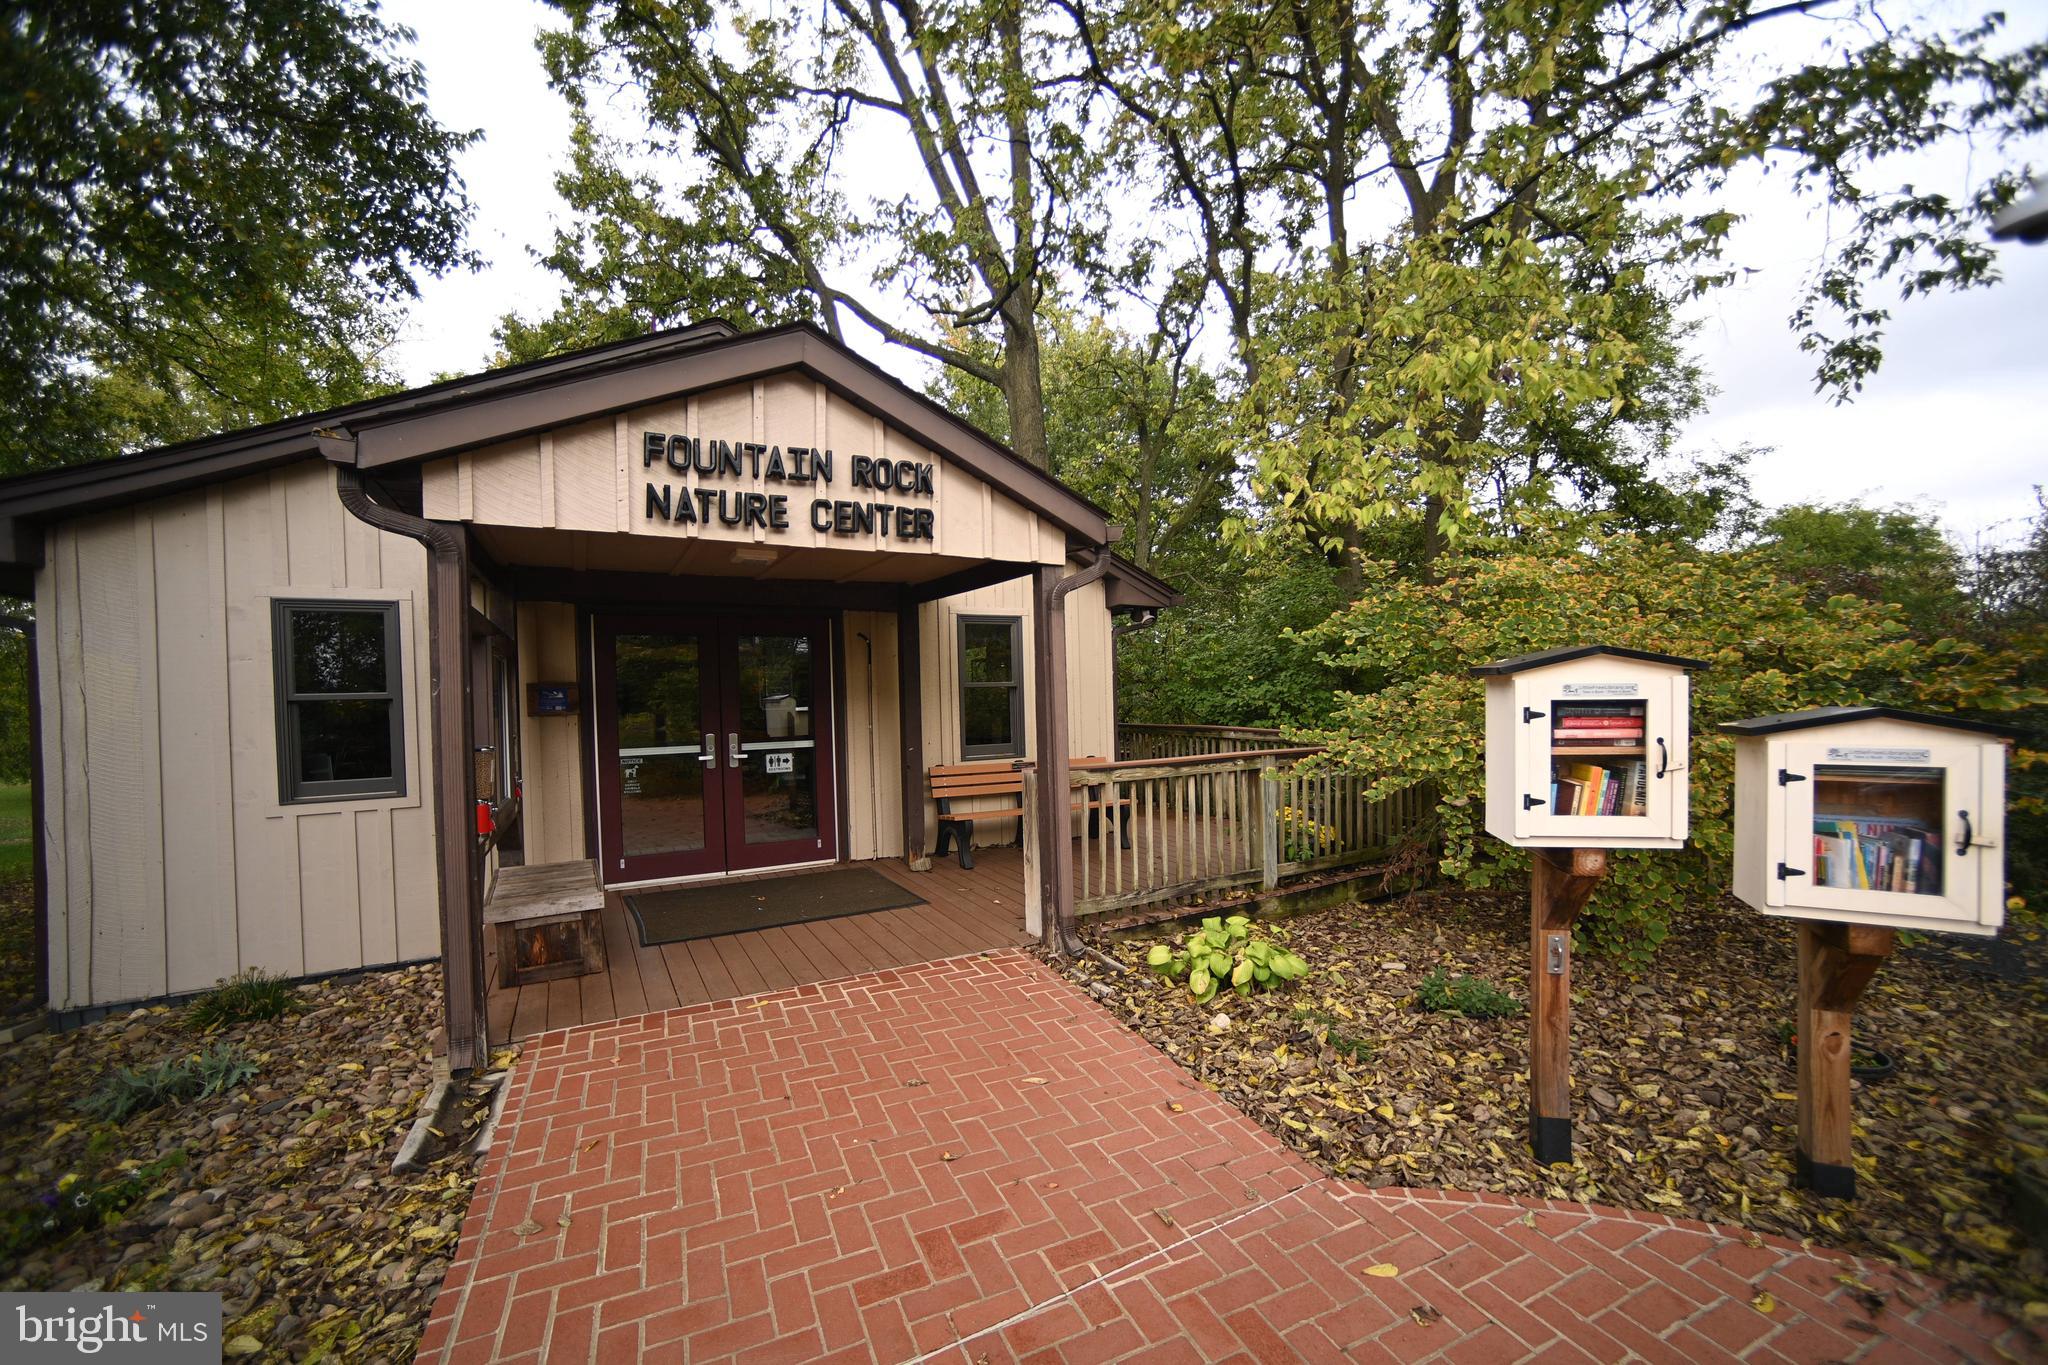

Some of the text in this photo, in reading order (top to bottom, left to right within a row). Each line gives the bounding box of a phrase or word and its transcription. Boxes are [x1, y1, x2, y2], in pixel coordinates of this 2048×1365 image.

[643, 431, 934, 495] FOUNTAIN ROCK
[646, 482, 934, 539] NATURE CENTER
